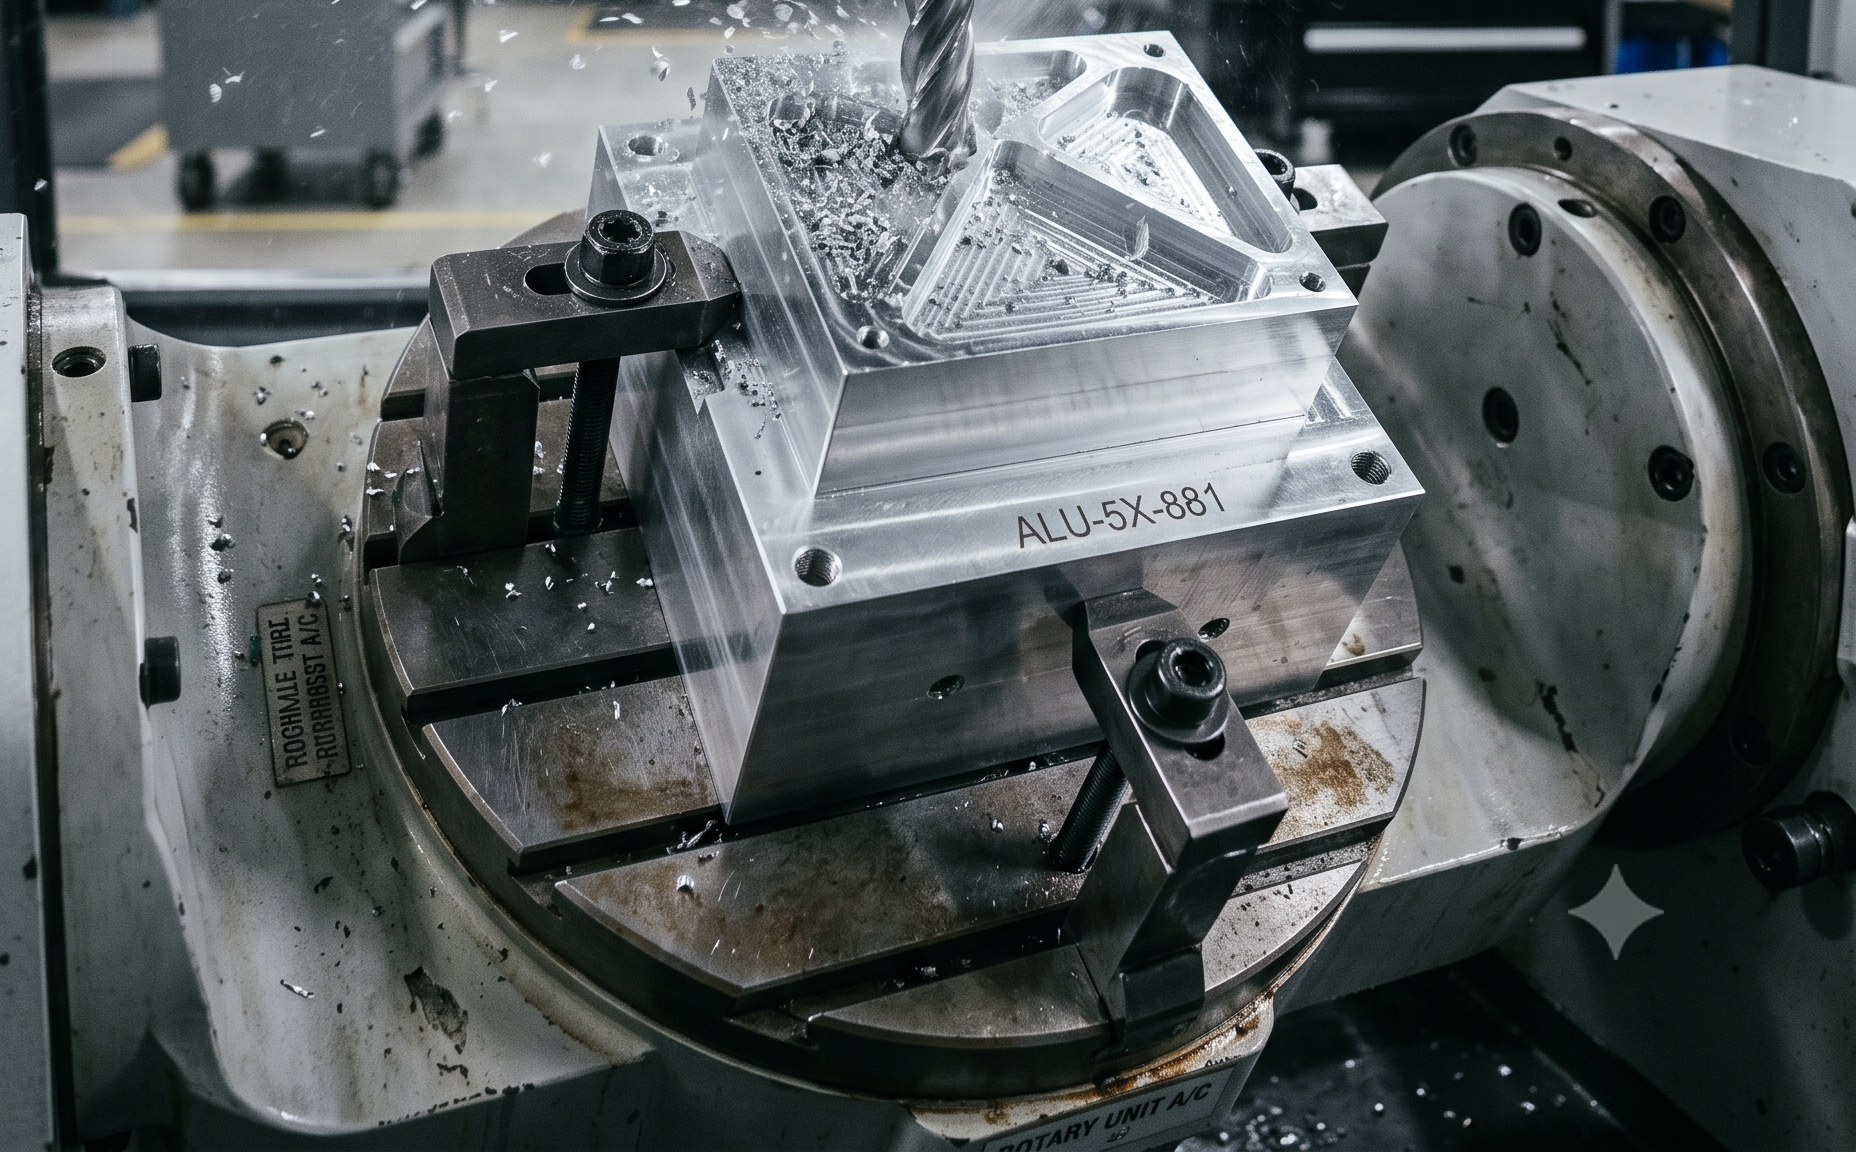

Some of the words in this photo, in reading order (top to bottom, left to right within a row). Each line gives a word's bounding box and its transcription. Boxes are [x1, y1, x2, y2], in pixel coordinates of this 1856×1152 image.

[1017, 482, 1225, 549] ALU-5X-881
[297, 613, 323, 647] A/C
[1104, 1096, 1167, 1129] UNIT
[1167, 1083, 1213, 1111] A/C
